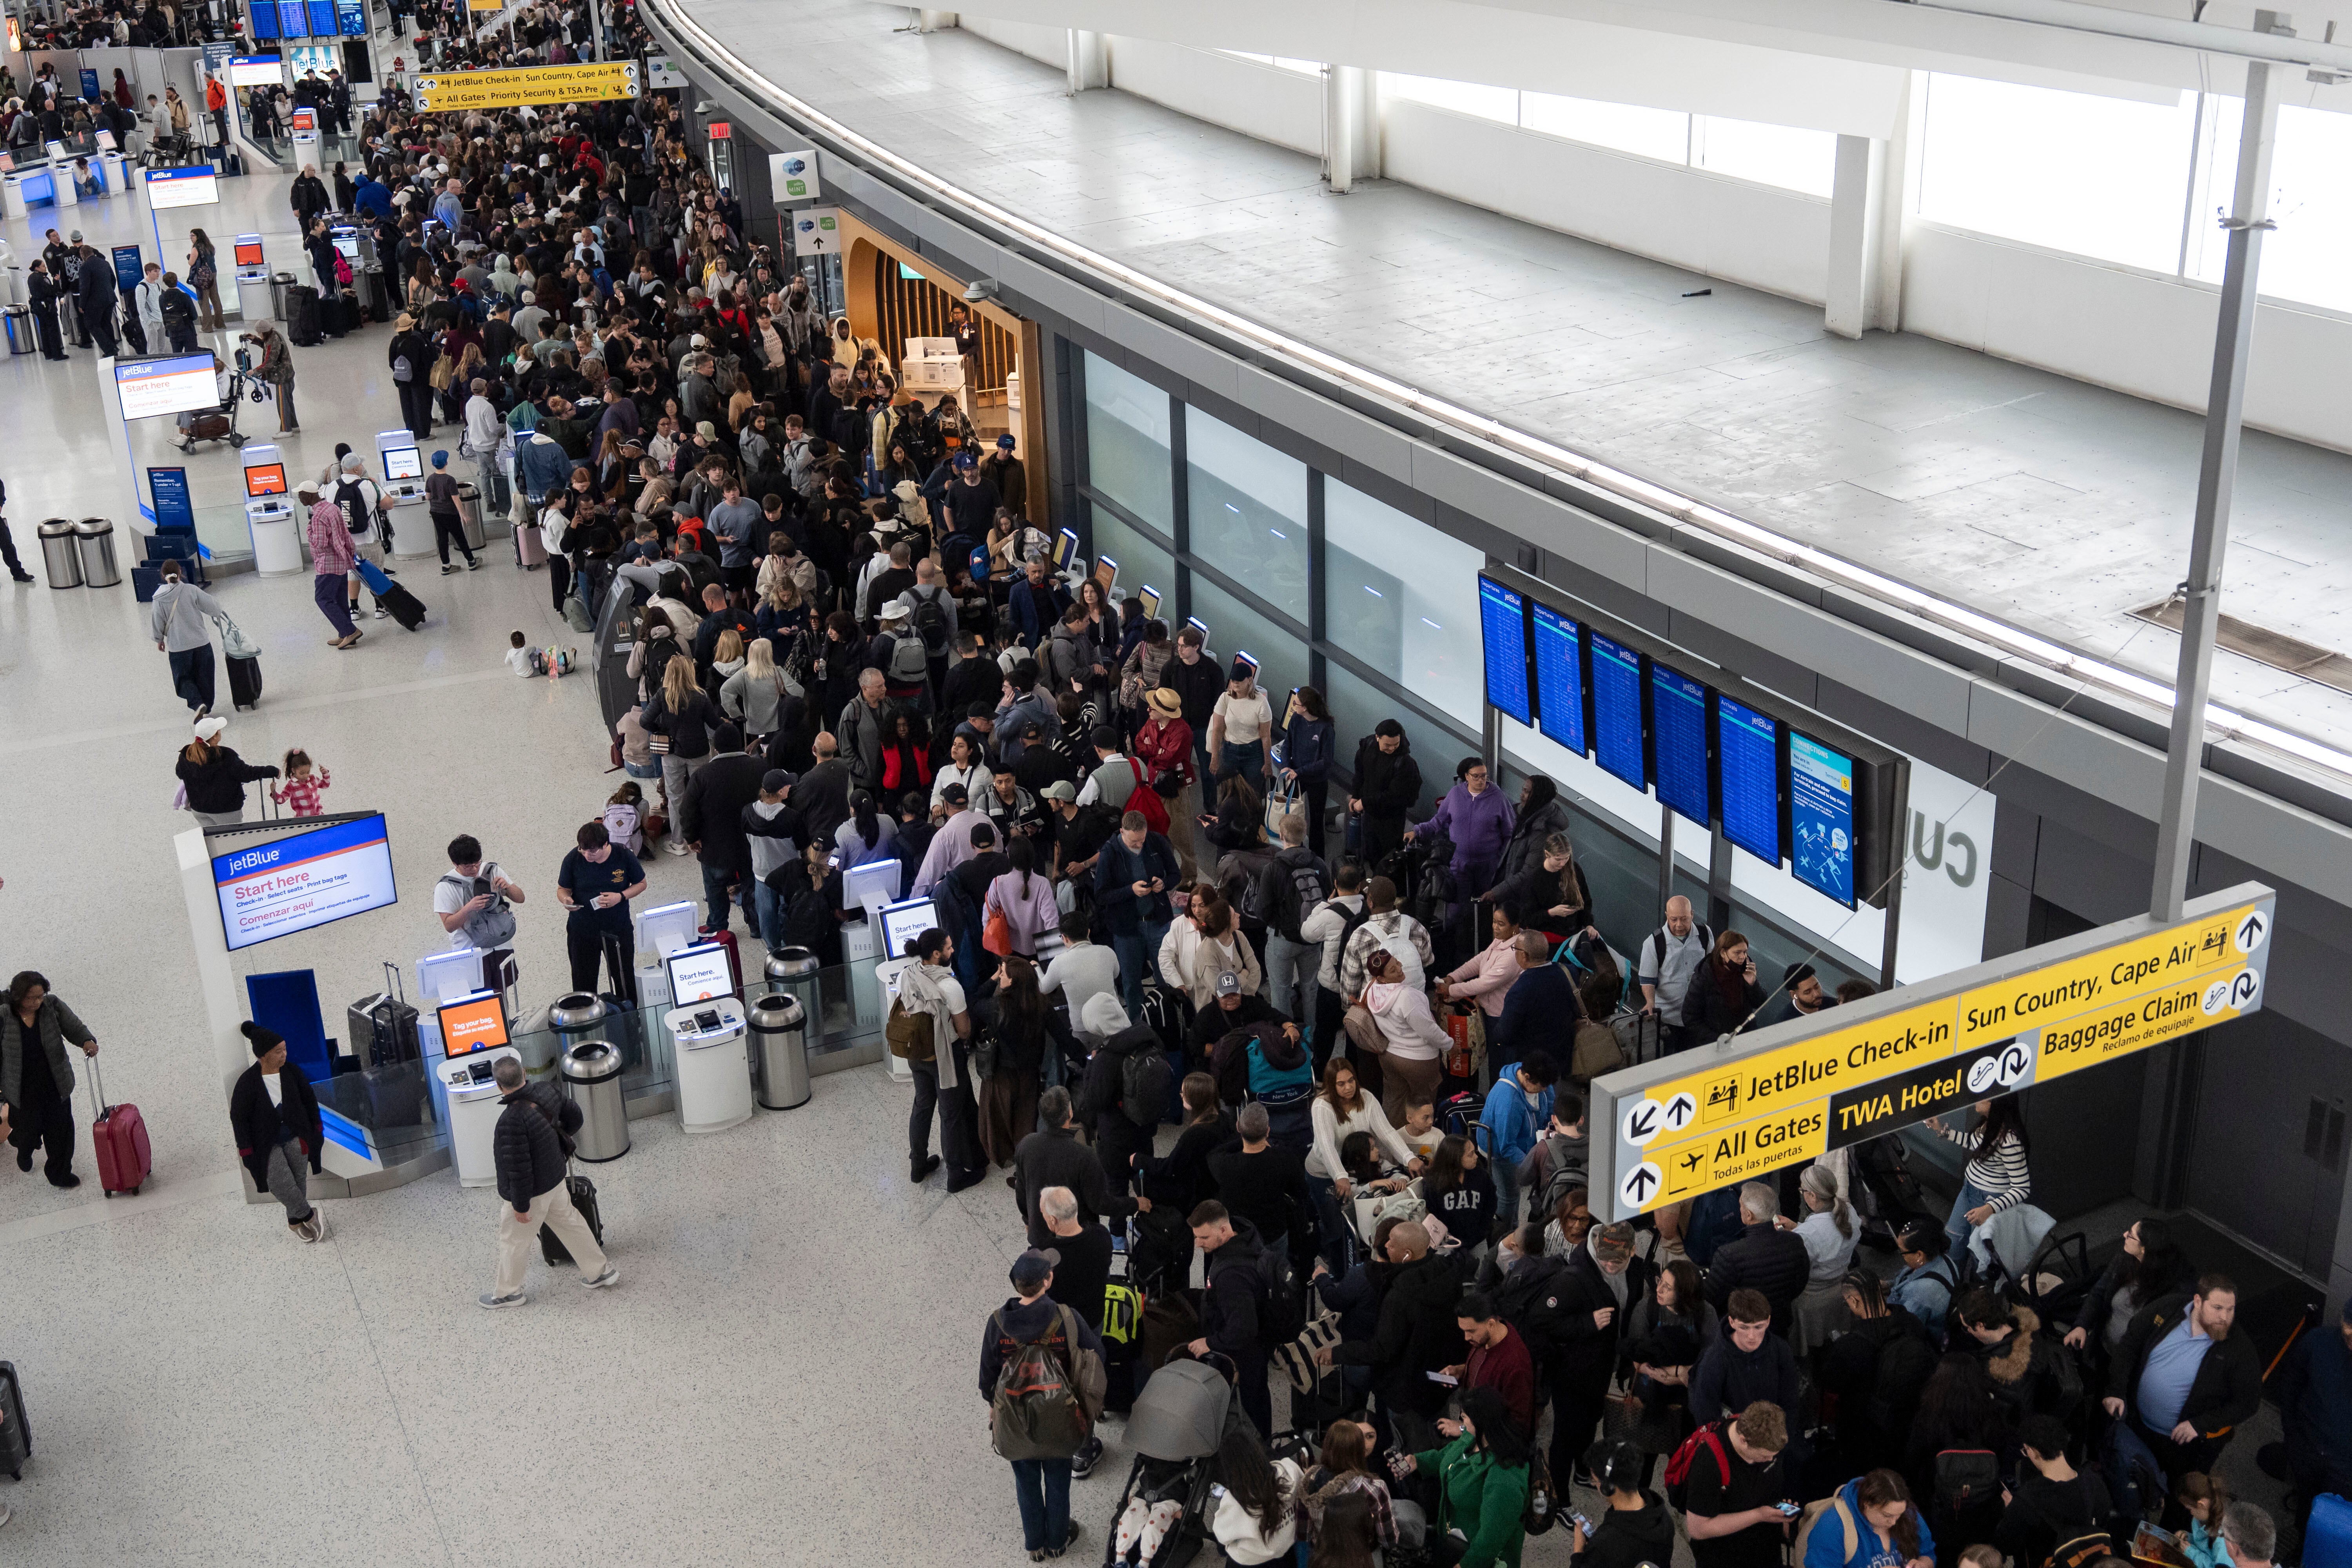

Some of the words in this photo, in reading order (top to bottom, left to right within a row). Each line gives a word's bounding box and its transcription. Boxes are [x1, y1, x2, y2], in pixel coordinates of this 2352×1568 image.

[296, 58, 335, 72] jetBlue
[454, 78, 483, 87] JetBlue
[486, 75, 520, 84] Check-in
[543, 73, 575, 81] Country,
[461, 94, 486, 102] Gates
[491, 91, 521, 100] Priority
[524, 89, 555, 98] Security
[711, 124, 728, 138] EXIT
[123, 365, 152, 378] jetBlue
[126, 384, 149, 392] Start
[1481, 580, 1500, 593] Departures
[1504, 591, 1520, 606] jetBlue
[1534, 606, 1554, 620] Departures
[1559, 618, 1576, 633] jetBlue
[1593, 635, 1614, 650] Departures
[1619, 648, 1637, 664] jetBlue
[1654, 667, 1670, 679] Arrivals
[1683, 681, 1702, 698] jetBlue
[1721, 699, 1737, 711] Arrivals
[1752, 715, 1772, 732] jetBlue
[1793, 737, 1828, 759] CONNECTIONS
[1800, 774, 1814, 785] Airtrain
[1820, 785, 1830, 793] other
[1825, 771, 1840, 783] Terminal
[1794, 777, 1811, 790] terminals,
[1811, 785, 1826, 797] proceed
[1837, 797, 1847, 807] claim.
[229, 850, 279, 876] jetBlue
[235, 880, 274, 900] Start
[277, 872, 310, 889] here
[236, 896, 263, 908] Check-in
[267, 889, 286, 899] Select
[287, 885, 303, 893] seats
[322, 877, 334, 886] bag
[334, 873, 348, 882] tags
[239, 908, 290, 927] Comenzar
[293, 898, 314, 913] aquí
[241, 924, 261, 933] Check-in
[263, 917, 287, 927] Seleccionar
[327, 901, 346, 909] etiquetas
[352, 894, 370, 902] equipaje
[895, 925, 912, 933] Start
[679, 973, 697, 981] Start
[1967, 1005, 2006, 1033] Sun
[2014, 976, 2103, 1016] Country,
[2111, 956, 2160, 985] Cape
[2166, 941, 2197, 969] Air
[452, 1029, 471, 1037] Etiquete
[477, 1023, 497, 1031] equipaje.
[465, 1020, 479, 1028] your
[2044, 1011, 2136, 1056] Baggage
[2143, 991, 2198, 1023] Claim
[2103, 1034, 2141, 1053] Reclamo
[2143, 1028, 2154, 1040] de
[2156, 1016, 2195, 1036] equipaje
[1748, 1058, 1838, 1102] JetBlue
[1847, 1021, 1949, 1069] Check-in
[1839, 1094, 1894, 1131] TWA
[1900, 1069, 1962, 1112] Hotel
[1714, 1130, 1746, 1163] All
[1755, 1113, 1822, 1149] Gates
[1713, 1165, 1743, 1181] Todas
[1746, 1157, 1761, 1169] las
[1763, 1145, 1802, 1169] puertas
[1444, 1190, 1481, 1210] GAP
